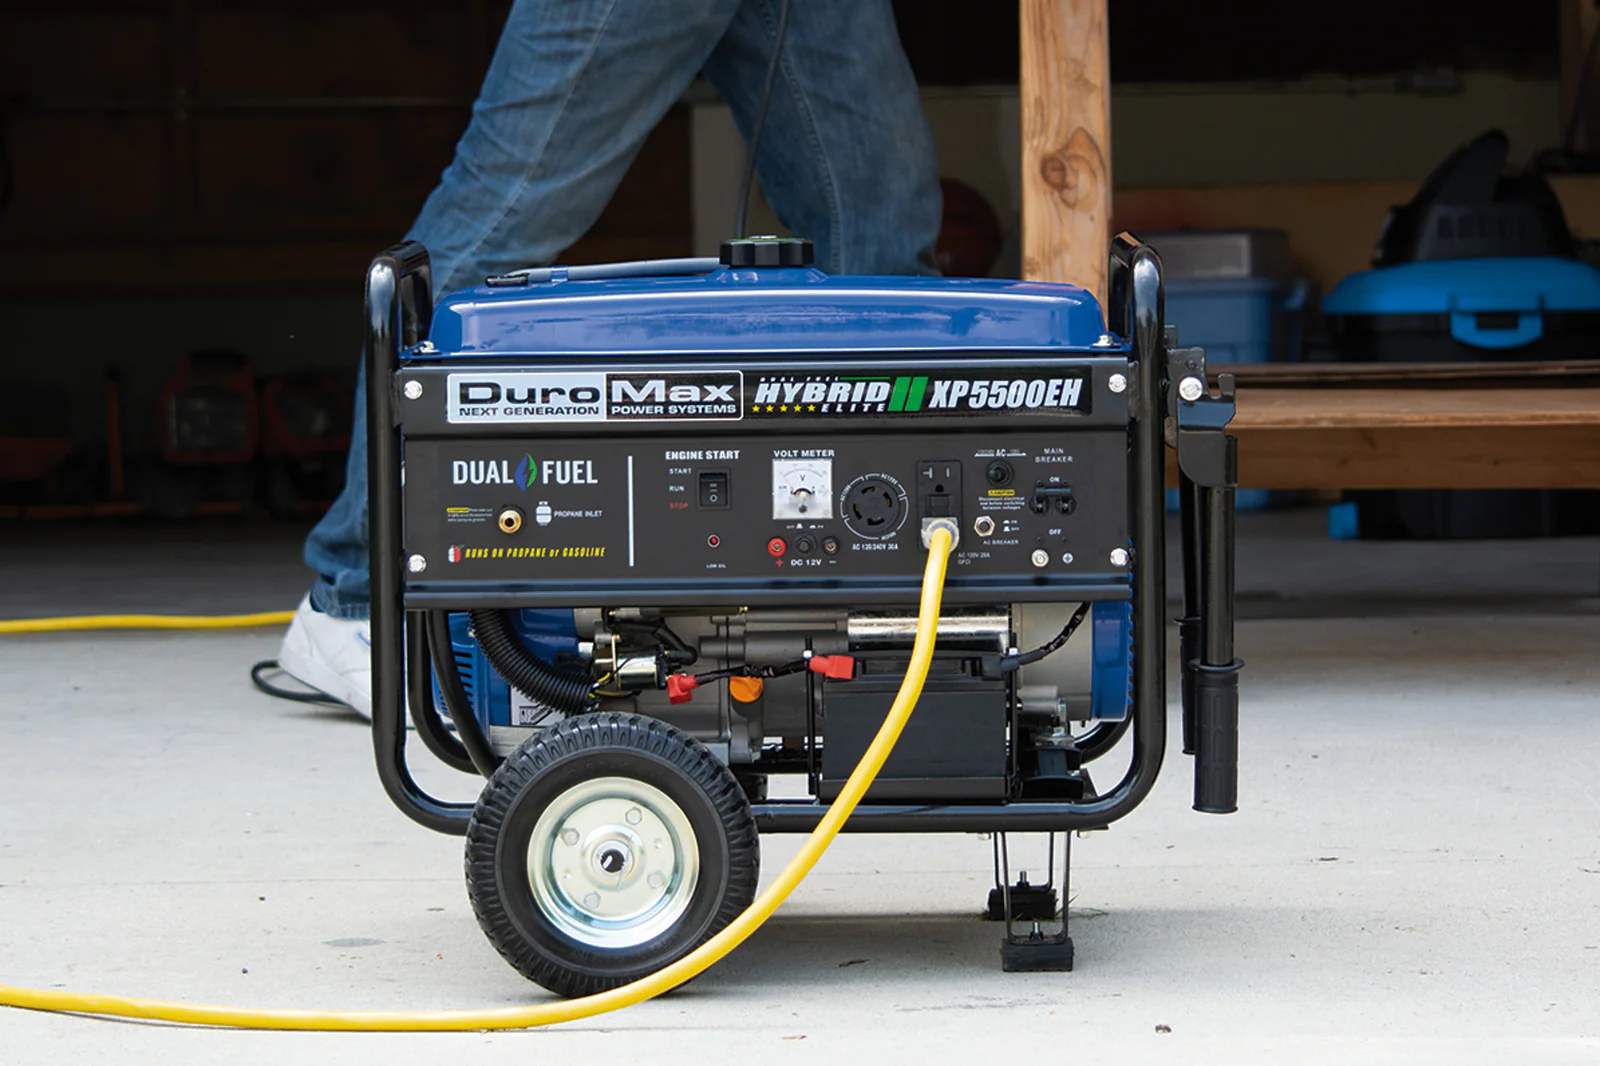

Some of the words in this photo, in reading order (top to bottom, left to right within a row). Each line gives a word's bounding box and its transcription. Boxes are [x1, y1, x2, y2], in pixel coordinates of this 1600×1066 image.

[459, 382, 600, 405] Duro
[611, 380, 735, 402] Max
[754, 382, 891, 404] HYBRID
[928, 378, 1083, 408] XP5500EH
[459, 407, 498, 416] NEXT
[503, 406, 600, 416] GENERATION
[611, 406, 664, 415] POWER
[668, 405, 737, 414] SYSTEMS
[821, 403, 886, 412] ELITE
[665, 450, 704, 460] ENGINE
[705, 450, 740, 460] START
[801, 449, 835, 457] METER
[996, 448, 1006, 457] AC
[453, 460, 514, 485] DUAL
[542, 460, 598, 484] FUEL
[553, 510, 583, 518] PROPANE
[585, 510, 603, 518] INLET
[1048, 528, 1062, 536] OFF
[852, 543, 861, 551] AC
[465, 549, 489, 558] RUNS
[492, 549, 503, 558] ON
[506, 548, 547, 558] PROPANE
[549, 549, 560, 558] or
[563, 547, 606, 558] GASOLINE
[790, 559, 803, 567] DC
